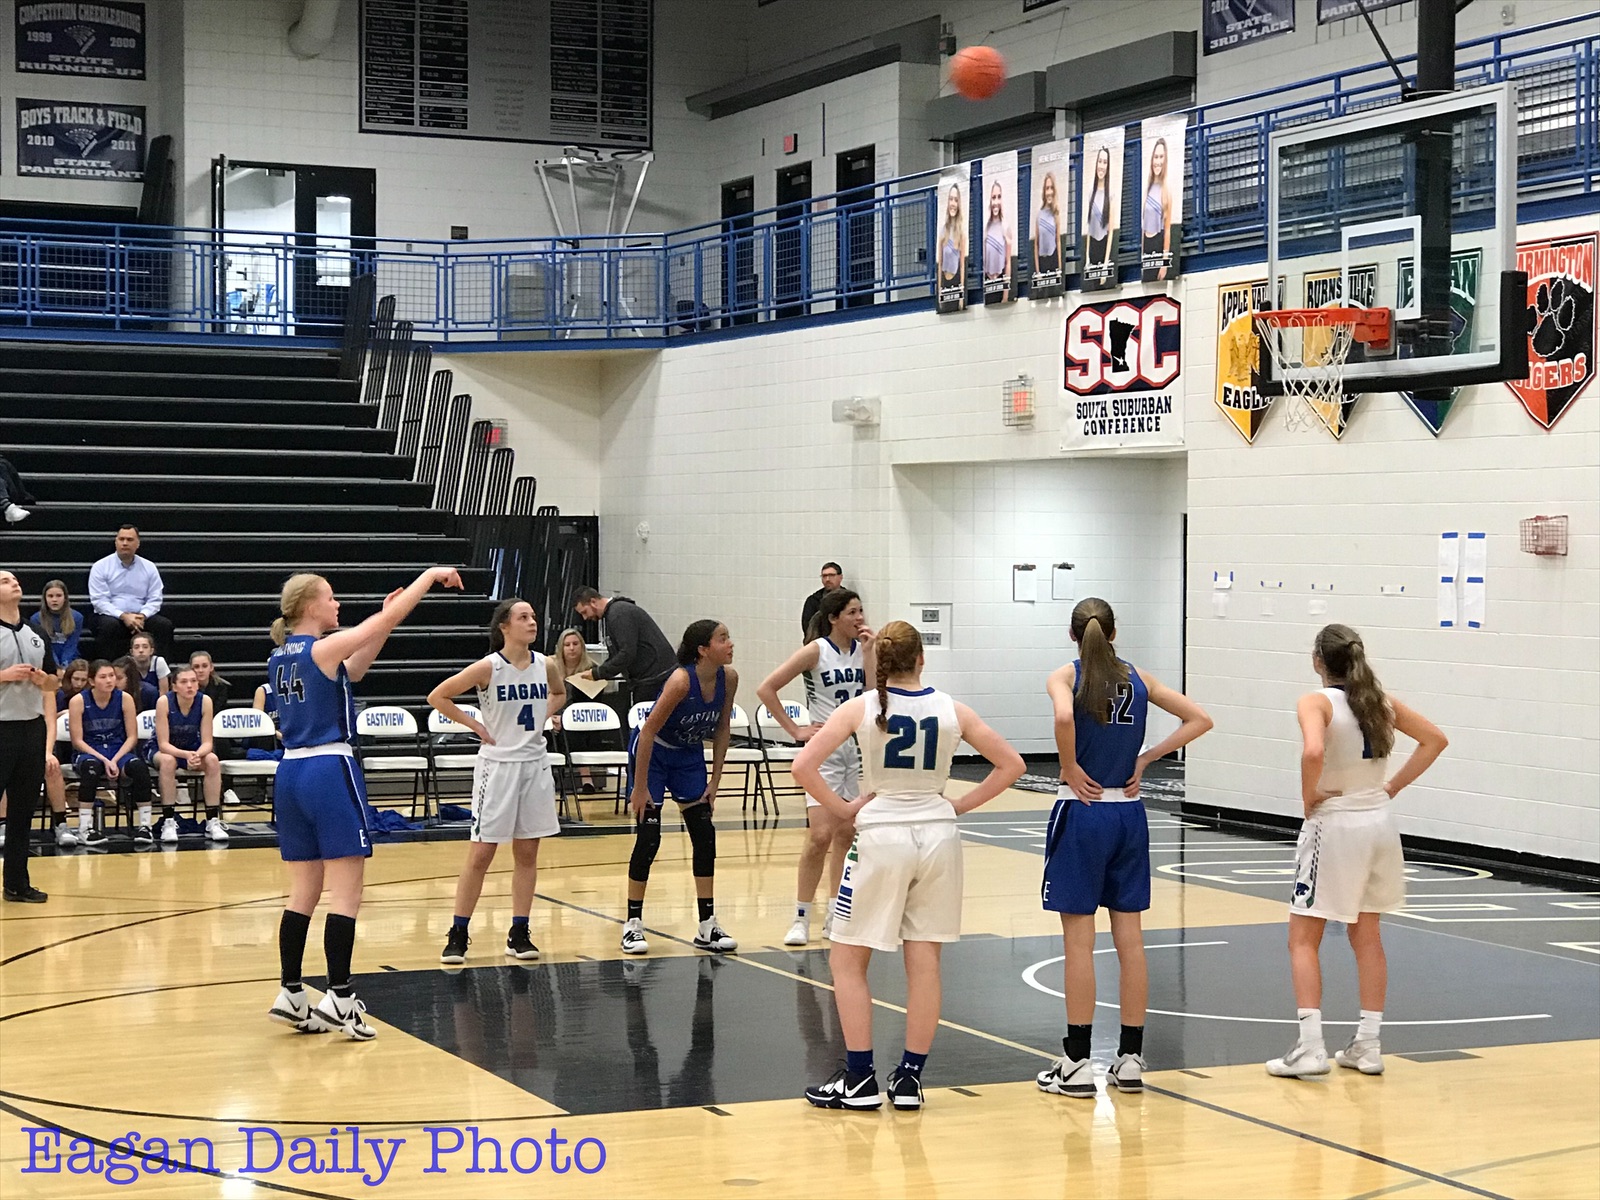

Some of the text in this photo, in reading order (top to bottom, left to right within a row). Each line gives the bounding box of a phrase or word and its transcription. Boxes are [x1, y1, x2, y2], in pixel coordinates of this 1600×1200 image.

[19, 3, 141, 34] COMPETITION CHEERLEADING
[1225, 13, 1272, 33] STATE
[27, 31, 53, 43] 1999
[110, 36, 136, 49] 2000
[1209, 20, 1290, 49] 3RD PLACE
[19, 61, 143, 75] RUNNER-UP
[48, 54, 114, 65] STATE
[20, 107, 51, 129] BOYS
[53, 106, 94, 125] TRACK
[96, 108, 106, 126] &
[107, 110, 142, 135] FIELD
[26, 134, 54, 146] 2010
[111, 140, 136, 151] 2011
[20, 165, 144, 179] PARTICIPANT
[53, 158, 111, 168] STATE
[1516, 242, 1594, 293] ARMINGTON
[1307, 268, 1376, 309] BURNSILLE
[1221, 289, 1248, 332] APPLE
[1065, 297, 1180, 393] SSC
[1514, 352, 1587, 390] GERS
[1223, 384, 1272, 411] EAGL
[1076, 396, 1172, 420] SOUTH SUBURBAN
[1083, 416, 1161, 436] CONFERENCE
[275, 663, 305, 704] 44
[820, 668, 866, 687] EAGA
[496, 683, 547, 701] EAGAN
[222, 714, 261, 728] EASTVIEW
[365, 712, 404, 727] EASTVIEW
[517, 703, 535, 732] 4
[572, 709, 608, 722] EASTVIEW
[766, 706, 800, 719] EIEW
[883, 714, 938, 770] 21
[358, 829, 367, 847] E
[1043, 881, 1051, 901] E
